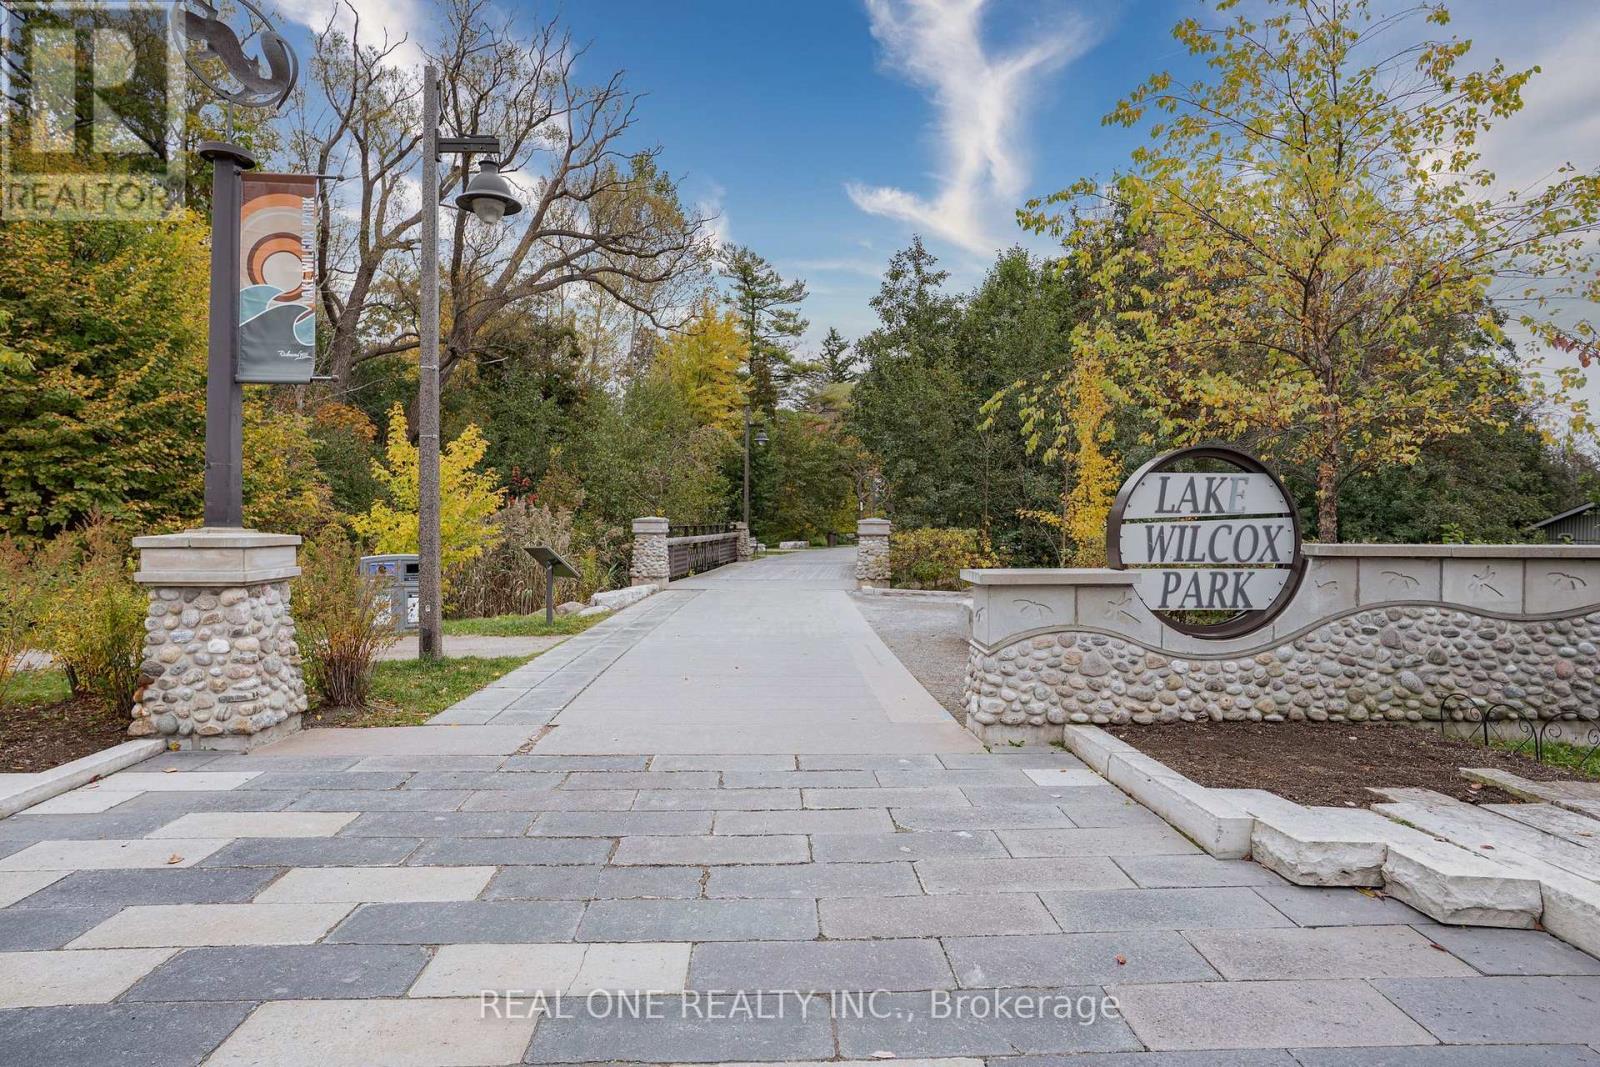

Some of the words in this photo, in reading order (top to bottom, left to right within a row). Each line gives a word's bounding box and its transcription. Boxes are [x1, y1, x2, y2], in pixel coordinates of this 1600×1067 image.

[302, 197, 314, 226] PARK
[301, 231, 314, 273] WILCOX
[301, 277, 314, 304] LAKE
[1154, 476, 1249, 514] LAKE
[1145, 524, 1284, 563] WILCOX
[1157, 571, 1255, 609] PARK
